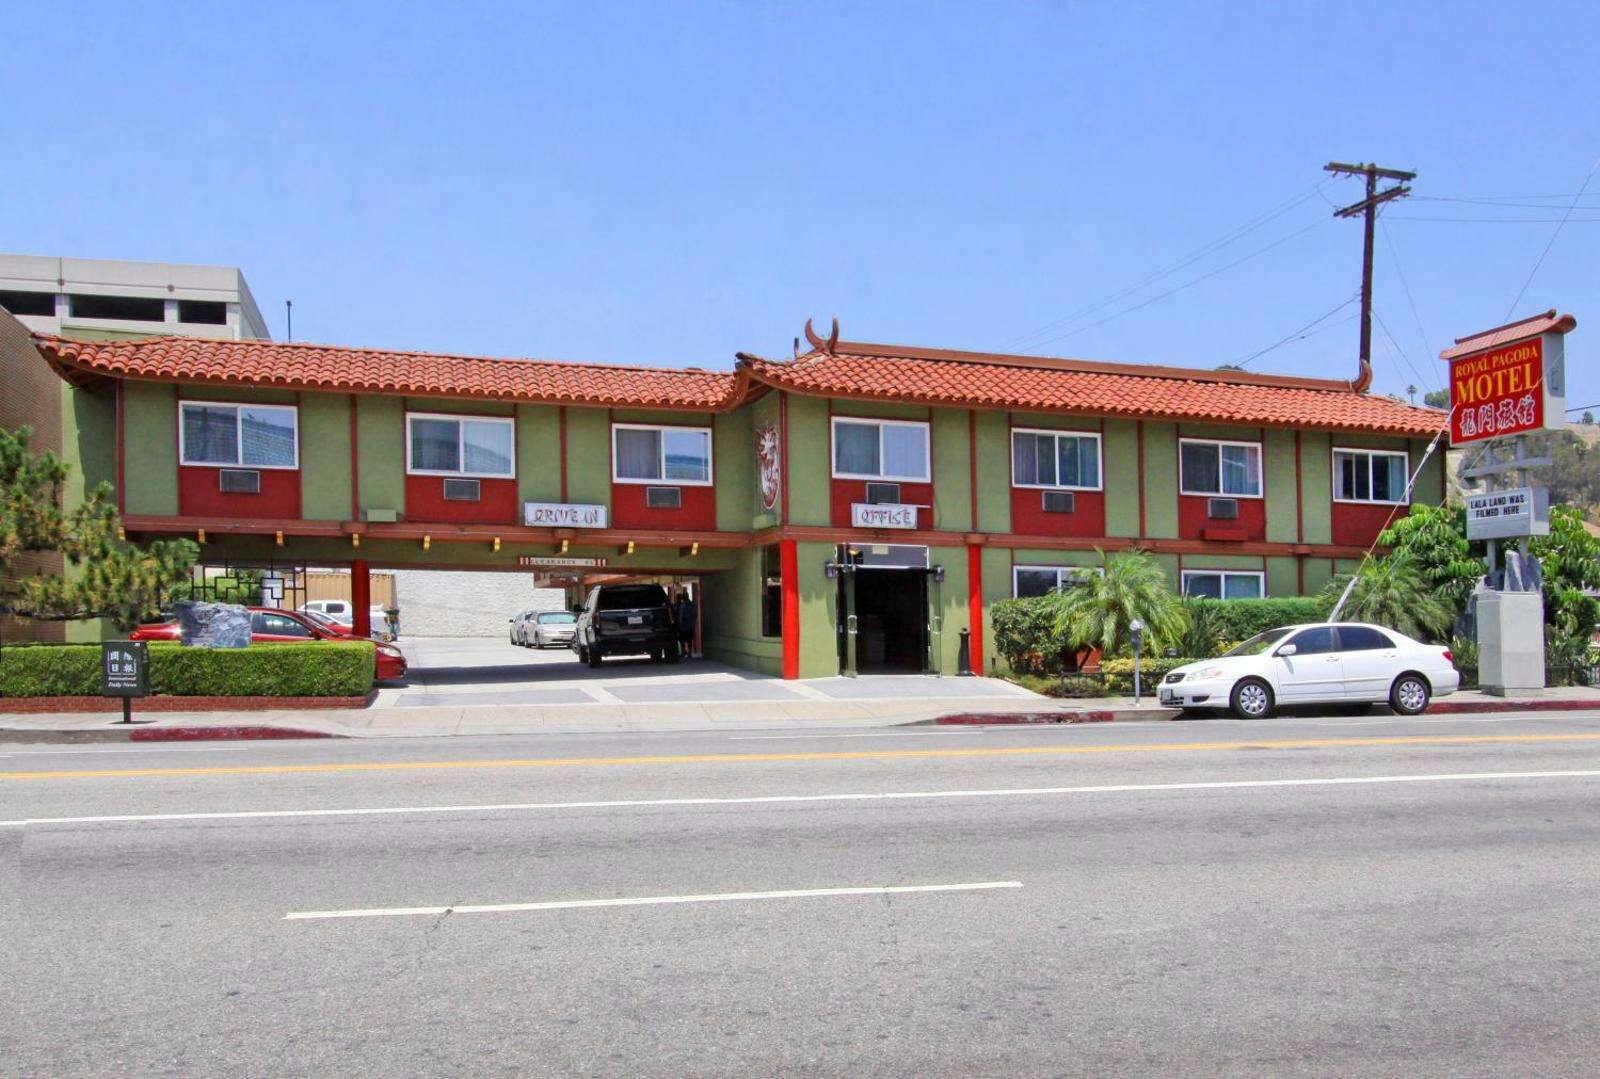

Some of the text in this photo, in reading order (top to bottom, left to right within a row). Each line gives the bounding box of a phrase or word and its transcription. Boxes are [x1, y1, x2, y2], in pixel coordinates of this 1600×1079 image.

[1455, 346, 1538, 378] ROYAL PAGODA
[1456, 362, 1534, 405] MOTEL
[1470, 494, 1525, 510] LALA LAND WAS
[861, 508, 912, 525] OFFICE
[1475, 505, 1520, 518] FILMED HERE
